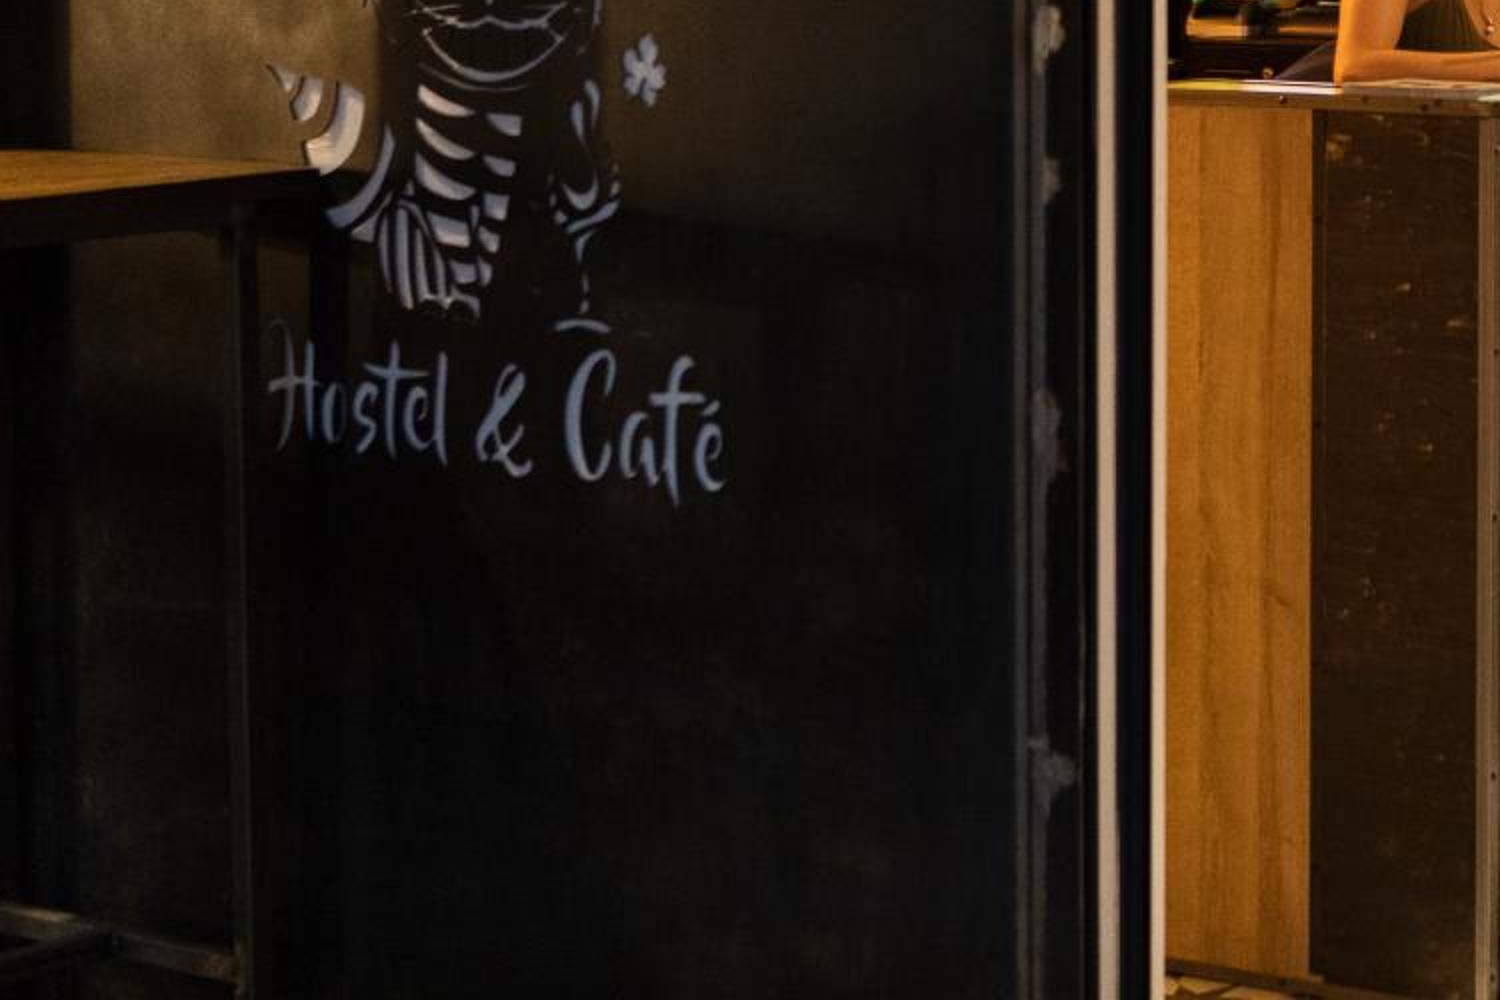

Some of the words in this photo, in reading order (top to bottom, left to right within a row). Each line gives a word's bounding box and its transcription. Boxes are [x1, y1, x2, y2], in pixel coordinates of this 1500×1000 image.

[267, 318, 448, 467] Hostel
[475, 363, 533, 478] &
[565, 348, 726, 507] Café
